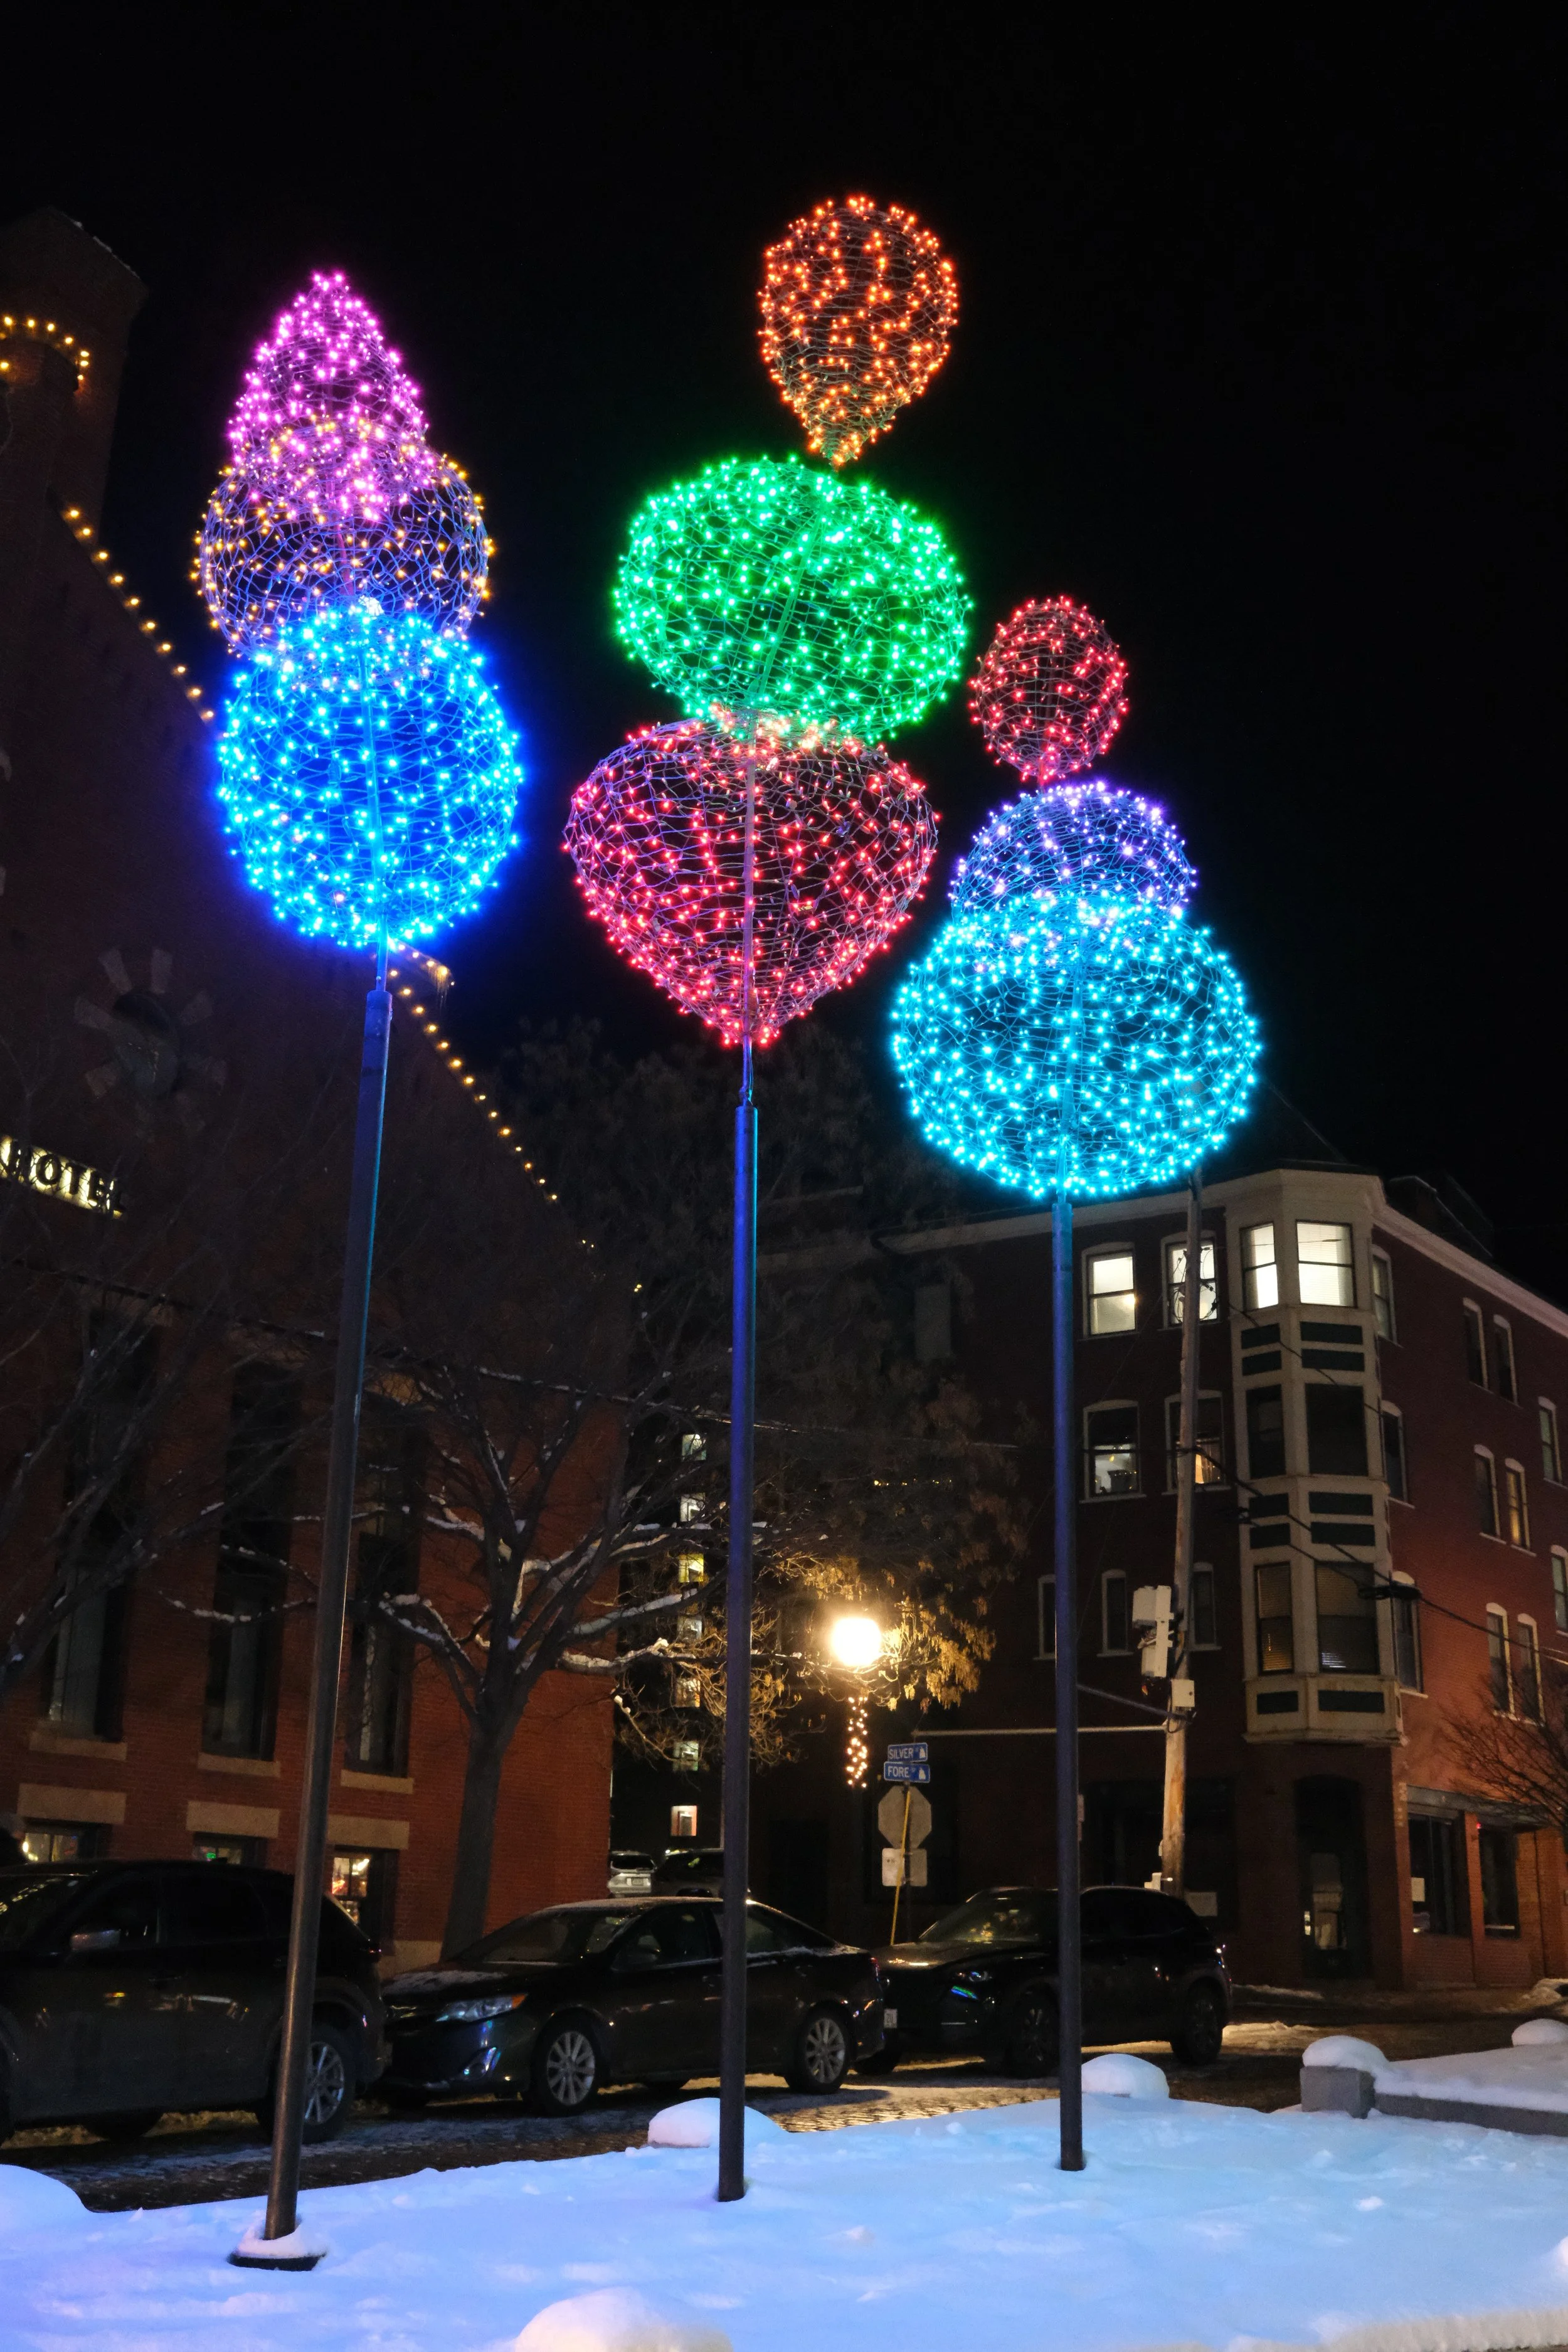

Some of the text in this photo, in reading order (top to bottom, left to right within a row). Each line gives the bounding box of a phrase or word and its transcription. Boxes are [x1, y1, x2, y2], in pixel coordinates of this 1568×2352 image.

[11, 1138, 127, 1212] HOTEL
[888, 1747, 913, 1759] SILVER
[887, 1766, 909, 1777] FORE
